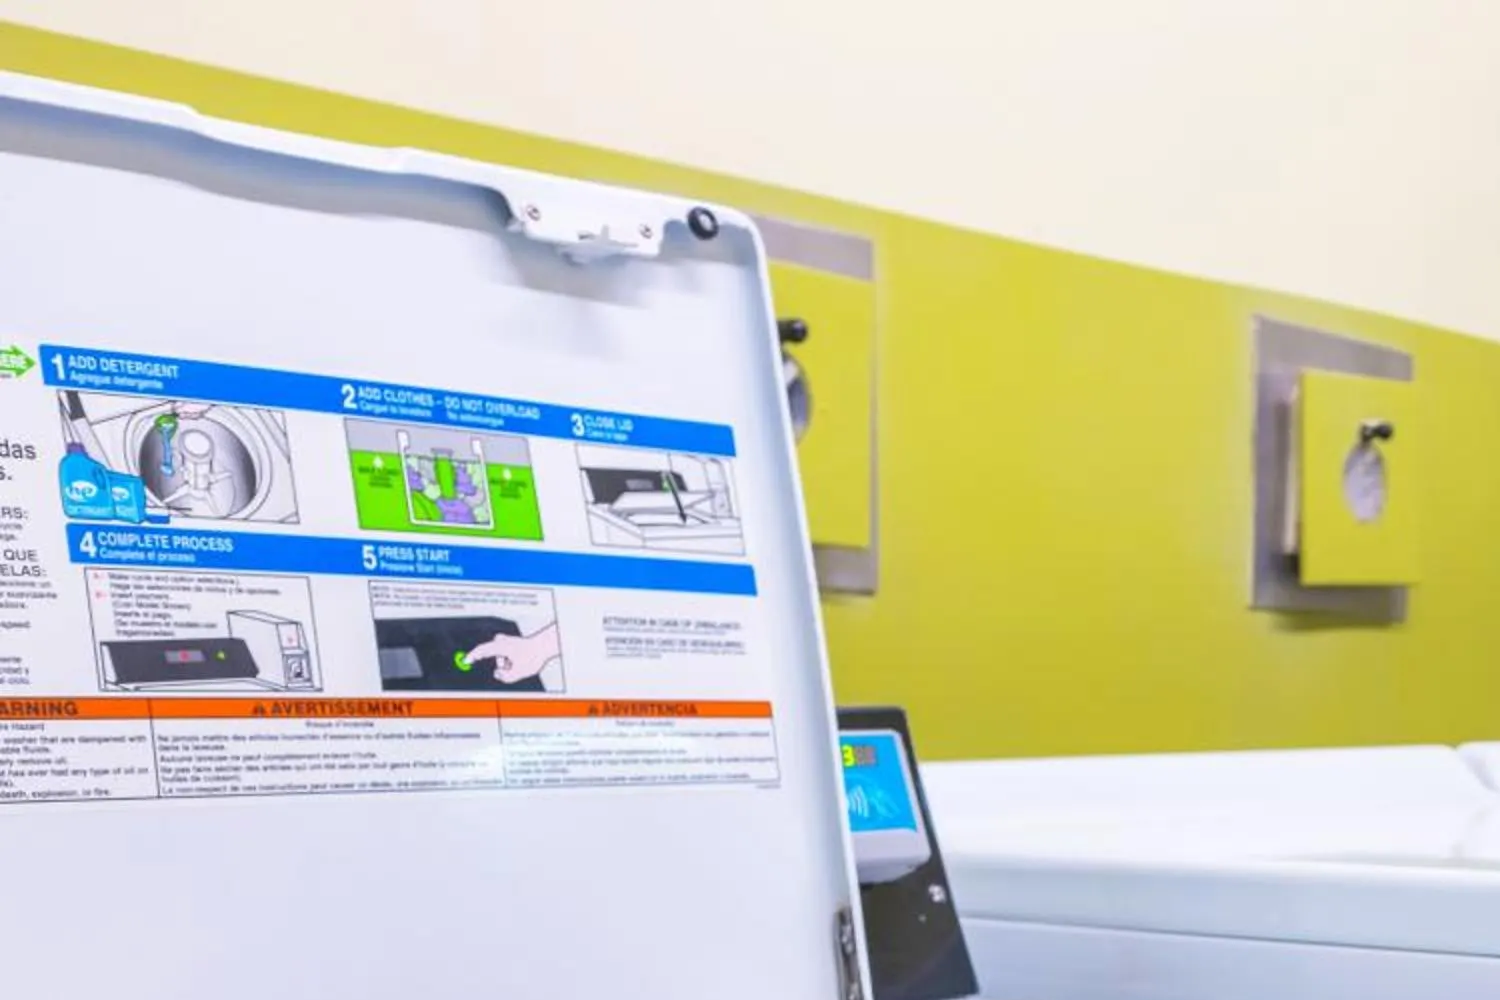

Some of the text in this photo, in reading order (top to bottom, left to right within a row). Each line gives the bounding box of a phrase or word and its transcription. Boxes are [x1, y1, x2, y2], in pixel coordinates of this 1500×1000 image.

[51, 353, 65, 380] 1
[68, 354, 179, 379] ADD DETERGENT
[69, 370, 164, 390] Agregue detergente
[341, 383, 357, 410] 2
[358, 385, 381, 402] ADD
[383, 388, 434, 407] CLOTHES
[444, 395, 460, 409] DO
[462, 397, 483, 413] NOT
[485, 400, 541, 420] OVERLOAD
[570, 413, 584, 437] 3
[584, 414, 634, 432] CLOSE LID
[0, 438, 36, 460] das
[80, 531, 96, 558] 4
[98, 531, 233, 553] COMPLETE PROCESS
[4, 549, 38, 562] QUE
[100, 547, 195, 564] Complete el proceso
[362, 544, 377, 570] 5
[378, 546, 449, 562] PRESS START
[271, 700, 414, 716] AVERTISSEMENT
[603, 701, 698, 717] ADVERTENCIA
